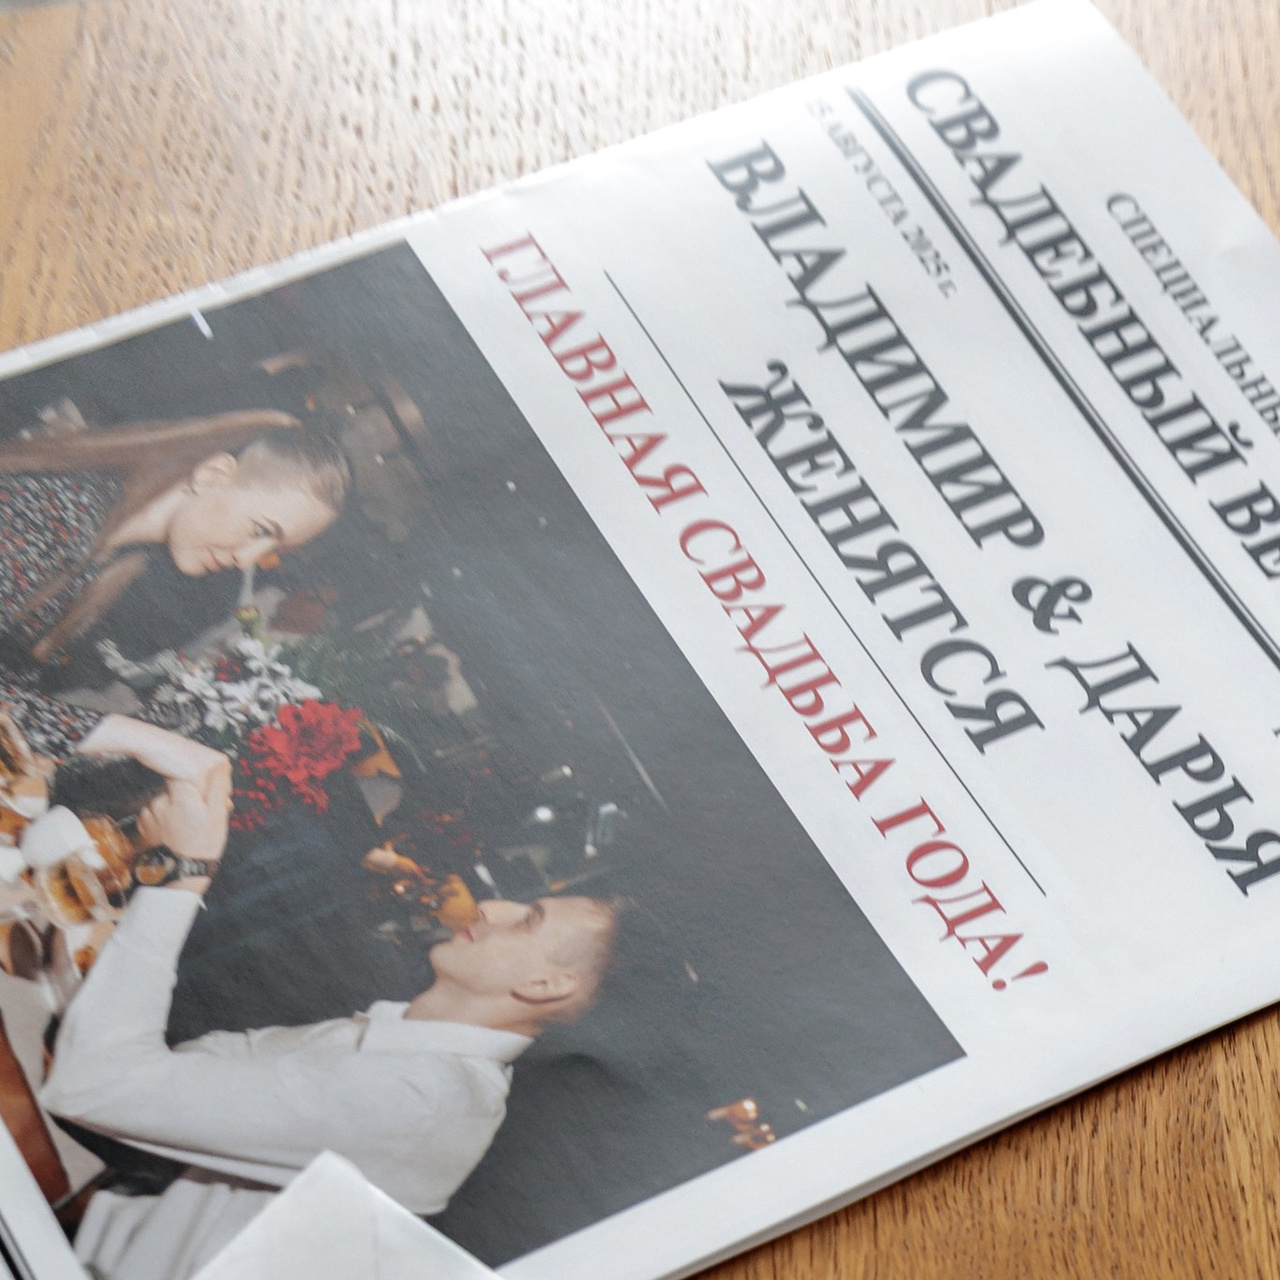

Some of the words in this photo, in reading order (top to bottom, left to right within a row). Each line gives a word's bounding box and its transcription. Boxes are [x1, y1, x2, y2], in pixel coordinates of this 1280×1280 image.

[706, 142, 1044, 550] ВЛАДИМИР
[1010, 576, 1093, 633] &
[906, 69, 1255, 485] СВАДЕБНЫЙ
[481, 232, 708, 515] ГЛАВНАЯ
[680, 519, 895, 800] СВАДЬБА
[871, 797, 1048, 990] ГОДА!
[719, 360, 1044, 755] ЖЕНЯТСЯ
